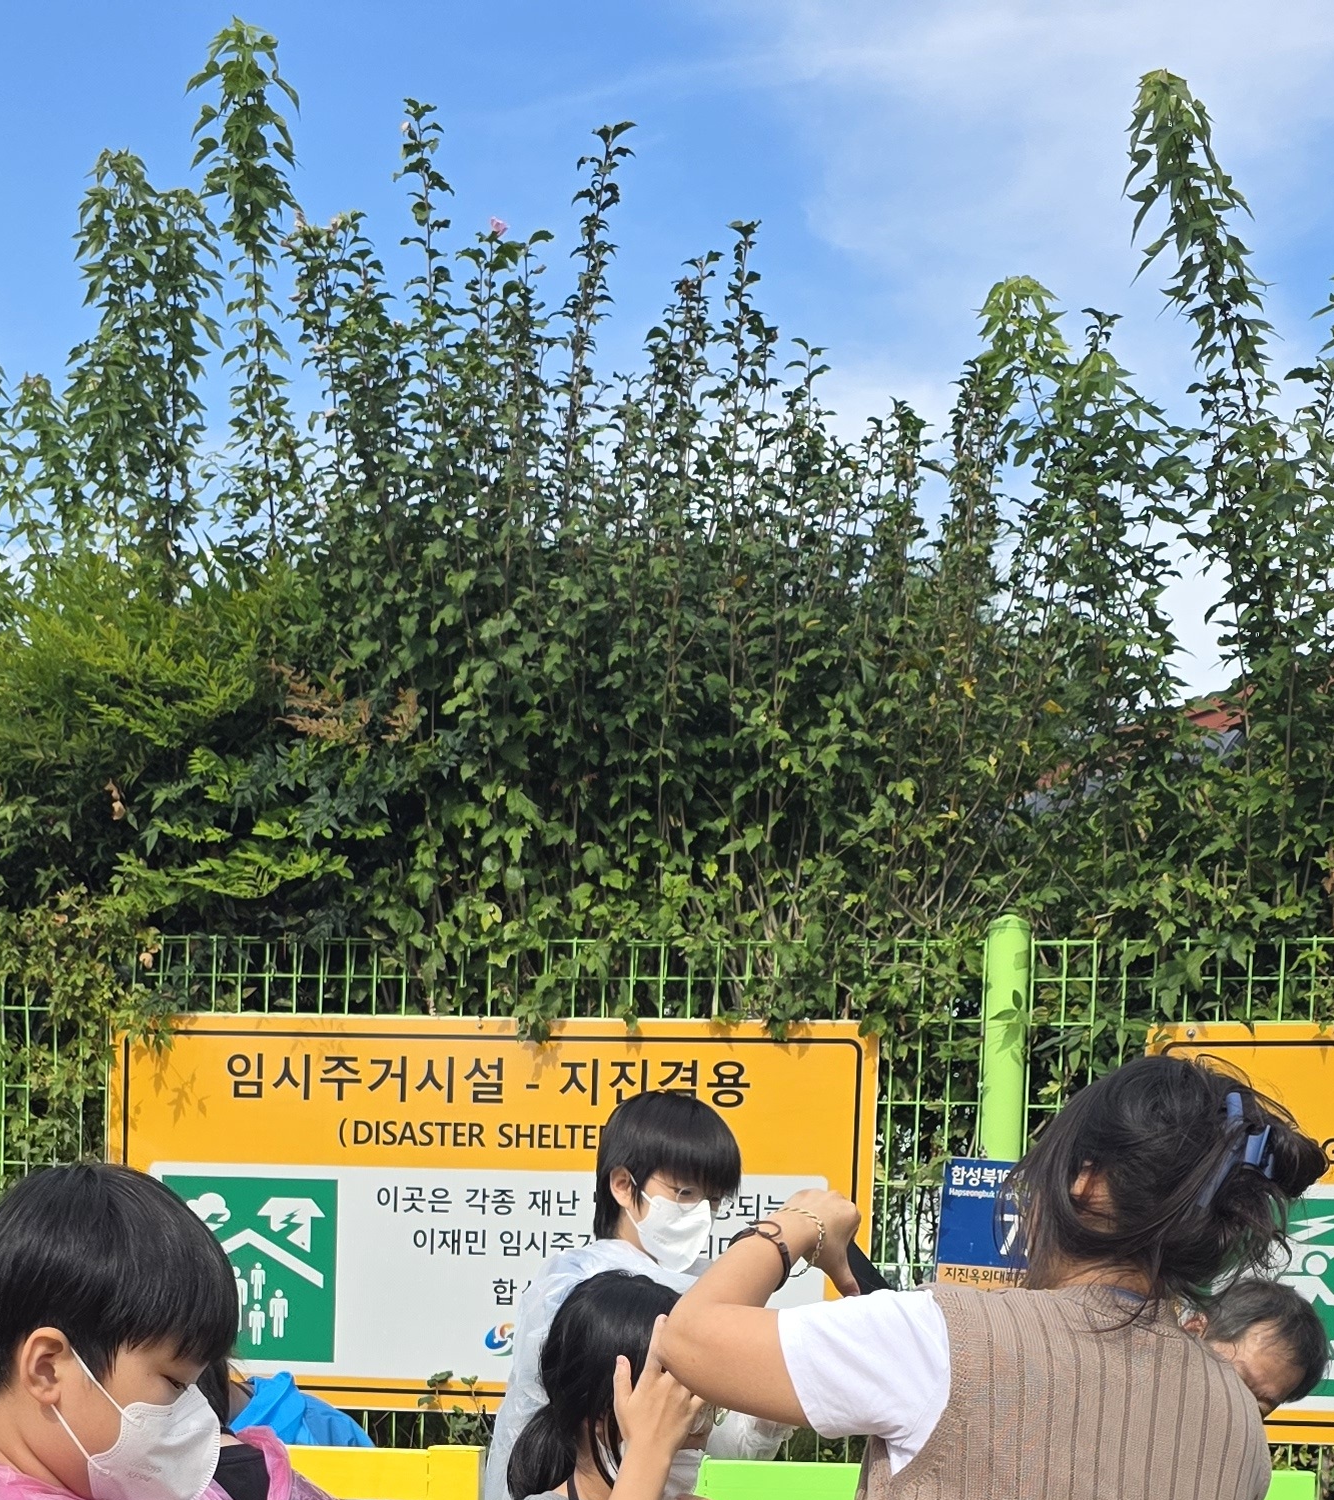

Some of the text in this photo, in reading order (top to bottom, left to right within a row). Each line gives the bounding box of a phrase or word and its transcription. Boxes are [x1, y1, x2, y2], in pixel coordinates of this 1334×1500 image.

[227, 1052, 504, 1104] 임시주거시설
[338, 1117, 607, 1150] (DISASTER SHELTE
[376, 1185, 453, 1214] 이곳은
[464, 1187, 516, 1216] 각종
[527, 1188, 581, 1217] 재난
[412, 1227, 487, 1256] 이재민
